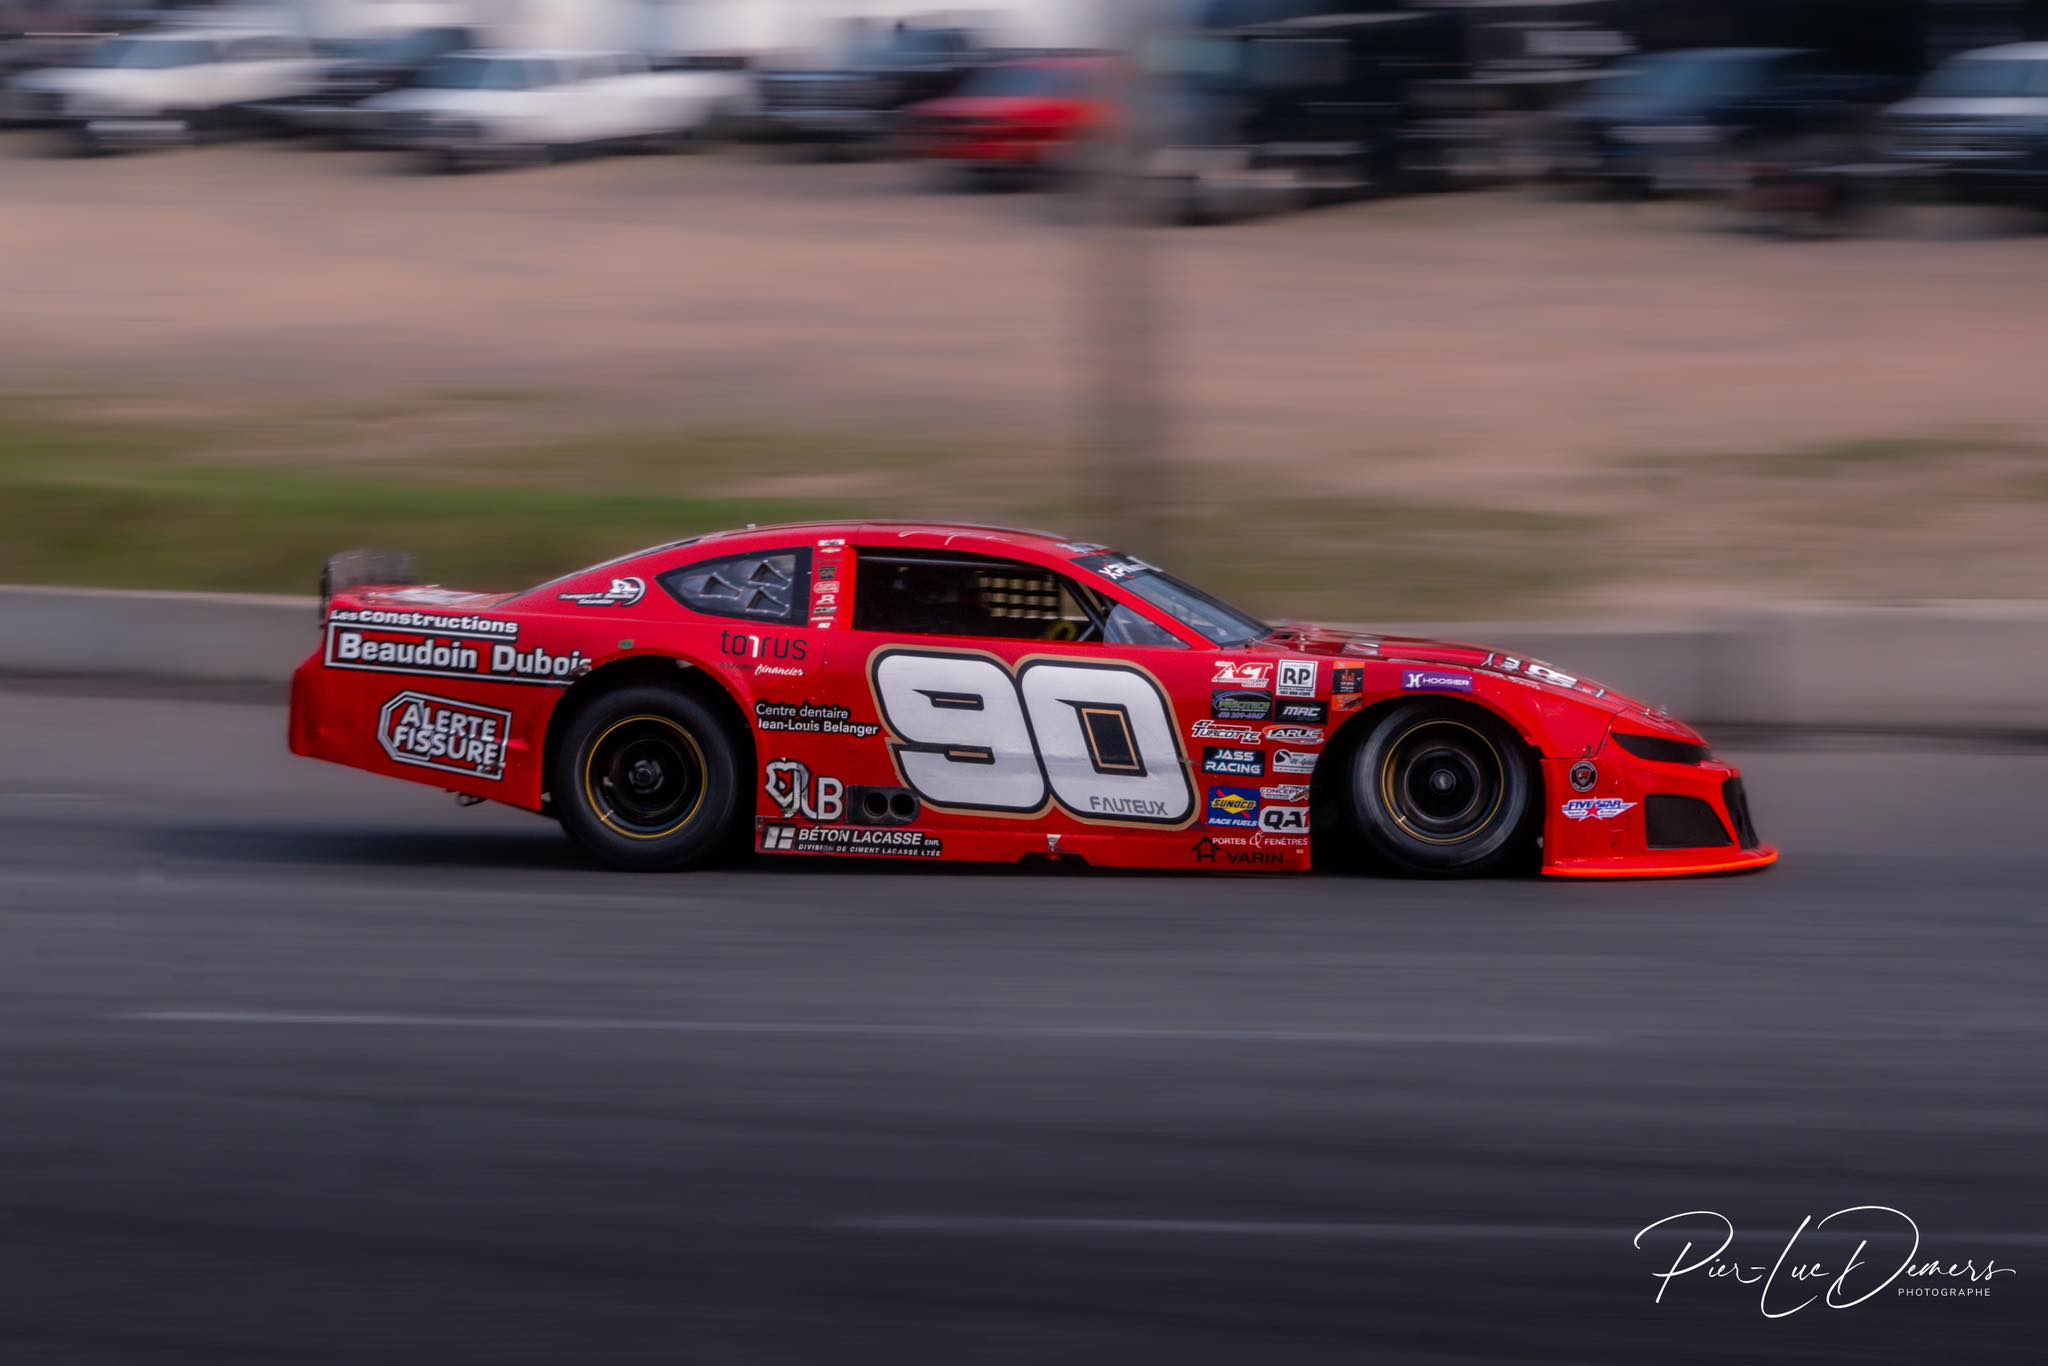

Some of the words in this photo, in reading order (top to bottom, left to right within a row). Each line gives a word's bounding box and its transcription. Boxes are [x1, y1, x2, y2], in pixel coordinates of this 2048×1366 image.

[338, 632, 478, 669] Beaudoin
[1282, 667, 1311, 685] RP
[1423, 677, 1470, 686] HOOSIER
[756, 703, 796, 717] Centre
[799, 705, 848, 719] dentaire
[1282, 706, 1320, 716] MAC
[400, 703, 497, 742] ALERTE
[823, 720, 878, 737] Belanger
[866, 643, 1201, 831] 90
[1267, 729, 1322, 739] LARUE
[393, 725, 498, 766] FISSURE
[1214, 750, 1254, 761] JASS
[1205, 761, 1261, 774] RACING
[1090, 796, 1168, 816] FAUTEUX
[1213, 799, 1255, 809] SUNOCO
[1568, 801, 1592, 810] FIVE
[1597, 800, 1621, 808] STAR
[1264, 810, 1310, 830] QA1
[798, 826, 850, 842] BÉTON
[852, 831, 922, 845] LACASSE
[1212, 837, 1246, 846] PORTES
[1249, 831, 1265, 848] &
[1264, 837, 1308, 846] FENÊTRES
[882, 848, 919, 856] LACASSE
[921, 849, 941, 857] LTÉE
[1226, 852, 1284, 864] VARIN
